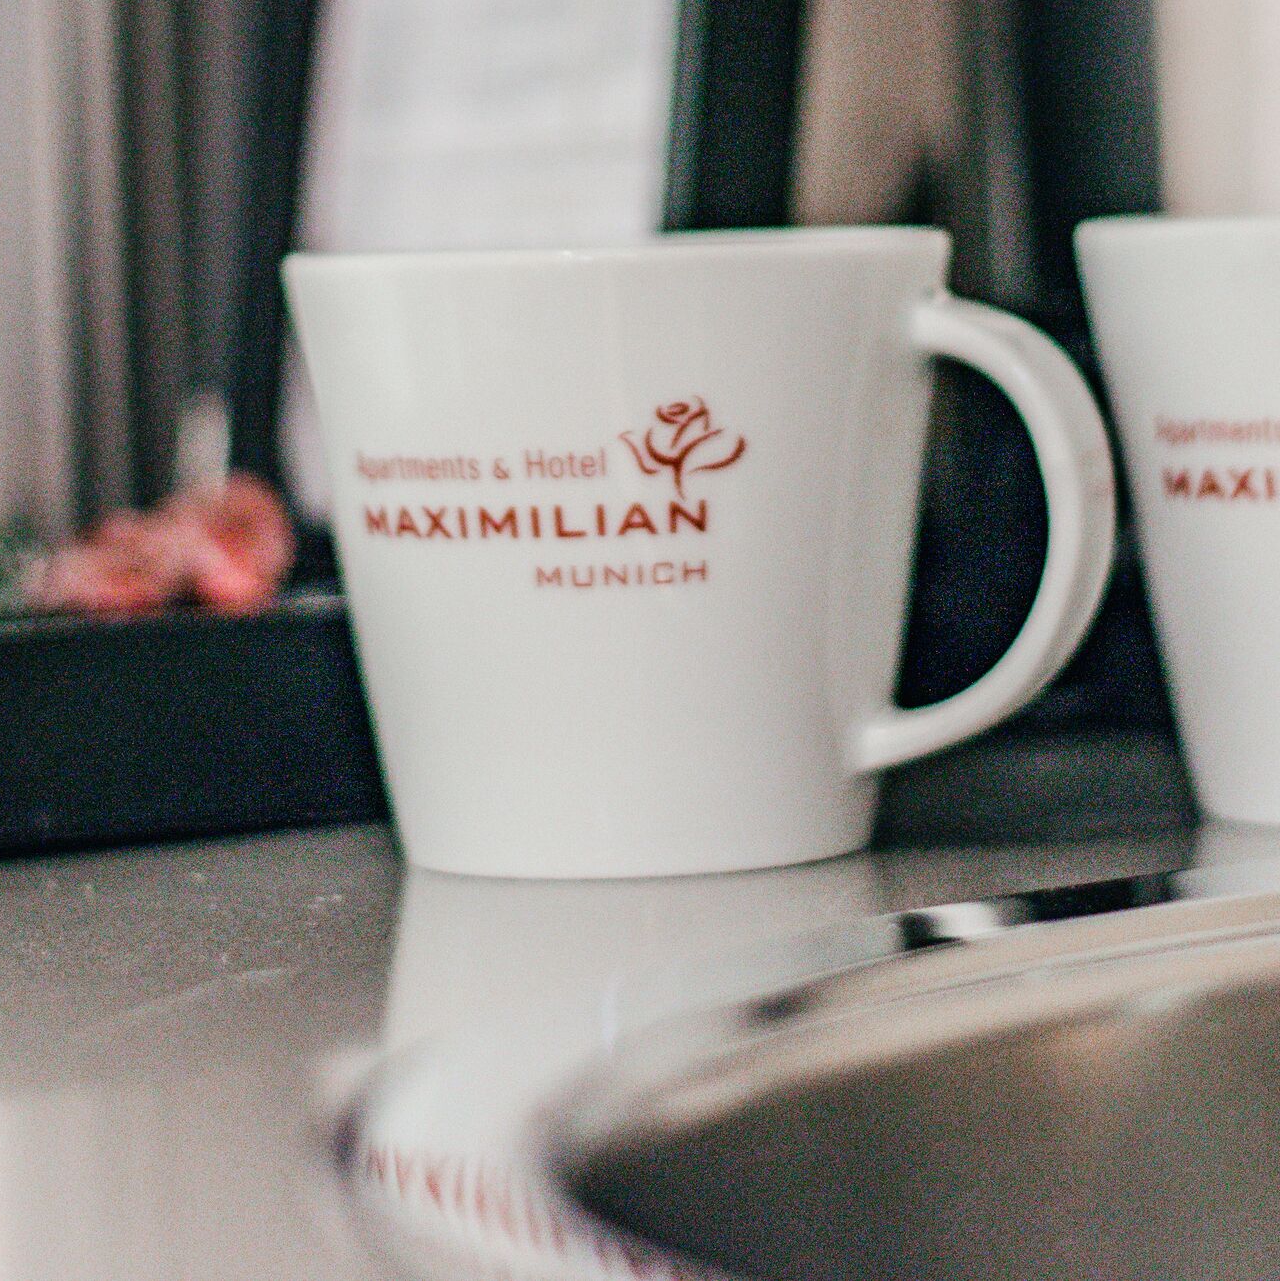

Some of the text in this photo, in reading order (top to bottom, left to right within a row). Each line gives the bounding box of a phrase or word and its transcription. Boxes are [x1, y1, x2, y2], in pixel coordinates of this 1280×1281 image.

[491, 456, 511, 481] &
[524, 447, 607, 480] Hotel
[363, 498, 709, 541] MAXIMILIAN
[534, 559, 710, 589] MUNICH
